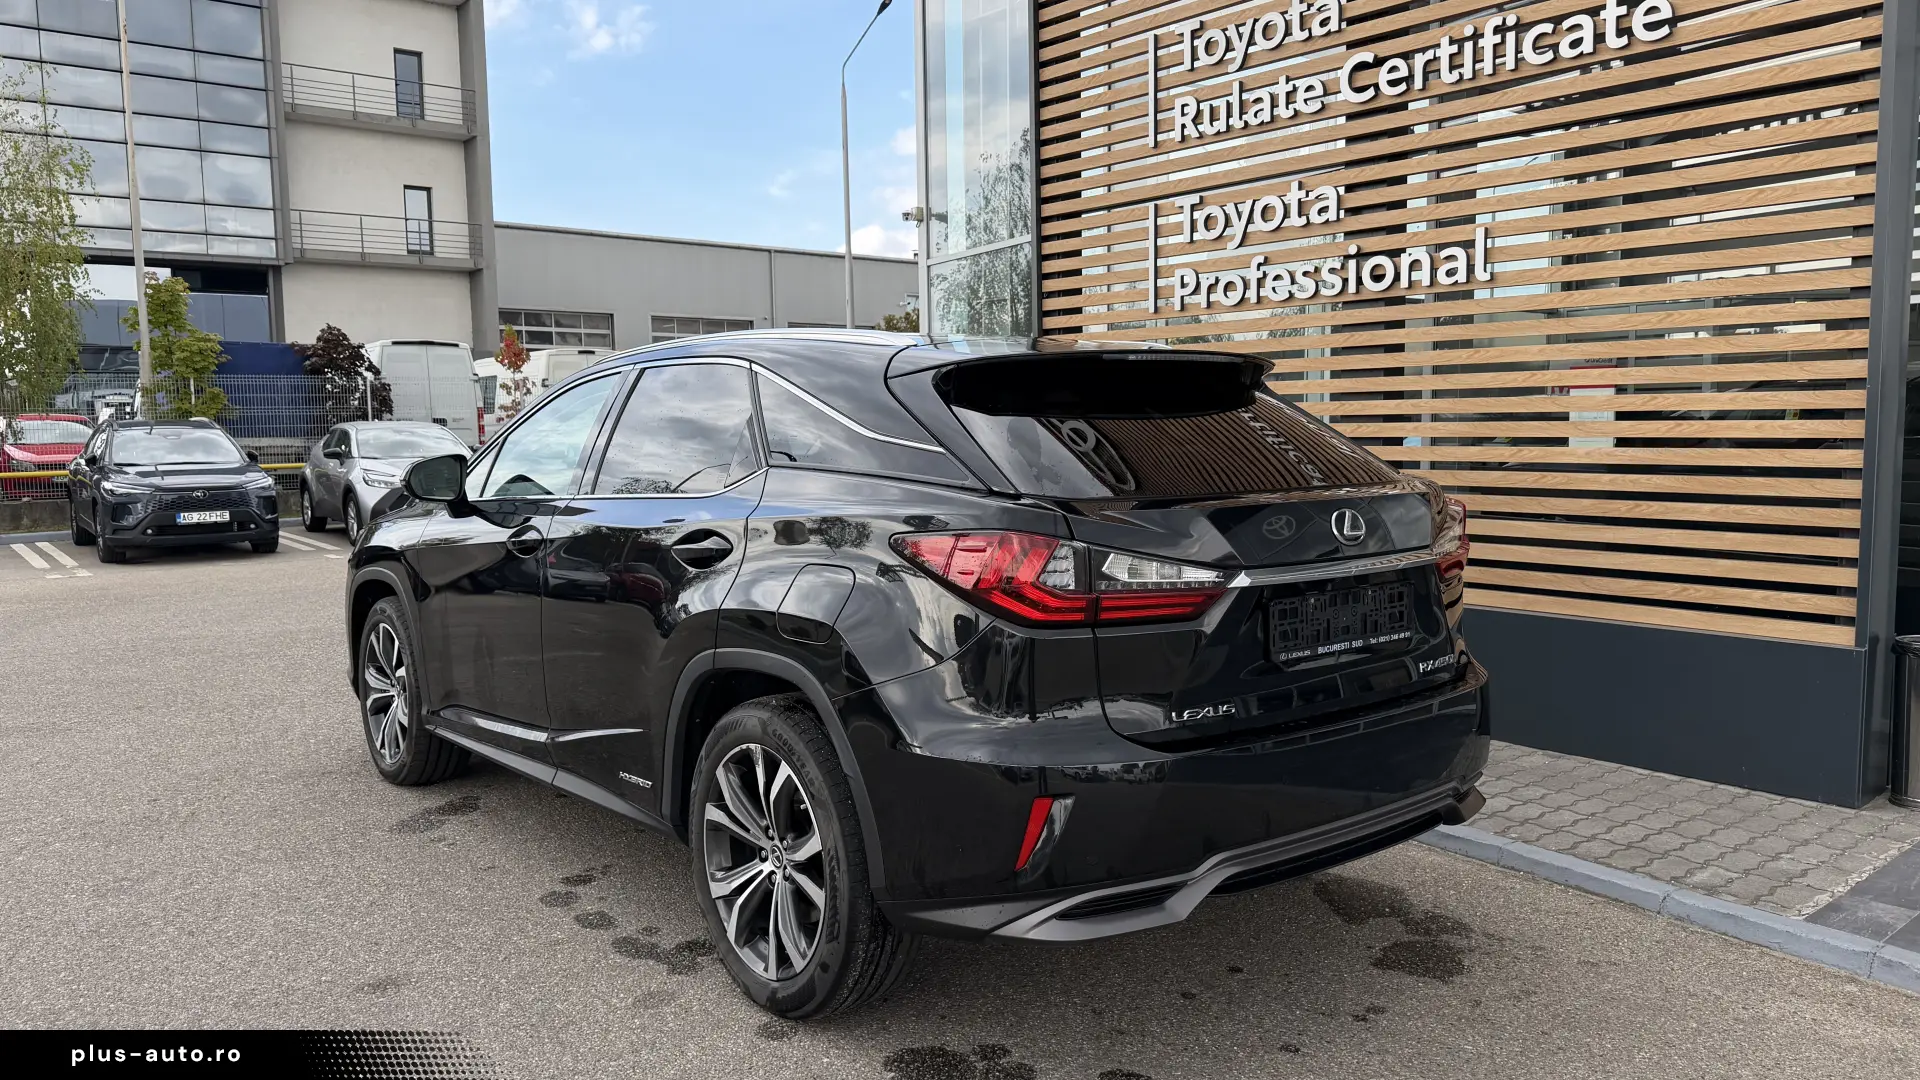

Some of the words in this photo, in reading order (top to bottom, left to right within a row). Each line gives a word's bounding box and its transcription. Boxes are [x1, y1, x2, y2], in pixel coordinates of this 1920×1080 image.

[1175, 0, 1341, 73] Toyota
[1175, 74, 1325, 142] Rulate
[1340, 0, 1674, 103] Certificate
[1175, 180, 1340, 250] Toyota
[1174, 227, 1492, 311] Professional
[182, 514, 194, 522] AG
[1288, 650, 1311, 659] LEXUS
[1317, 643, 1350, 654] BUCURESTI
[1351, 640, 1364, 649] SUD
[1419, 660, 1435, 673] RX
[1171, 703, 1236, 721] LEXUS
[618, 771, 653, 789] HYBRID
